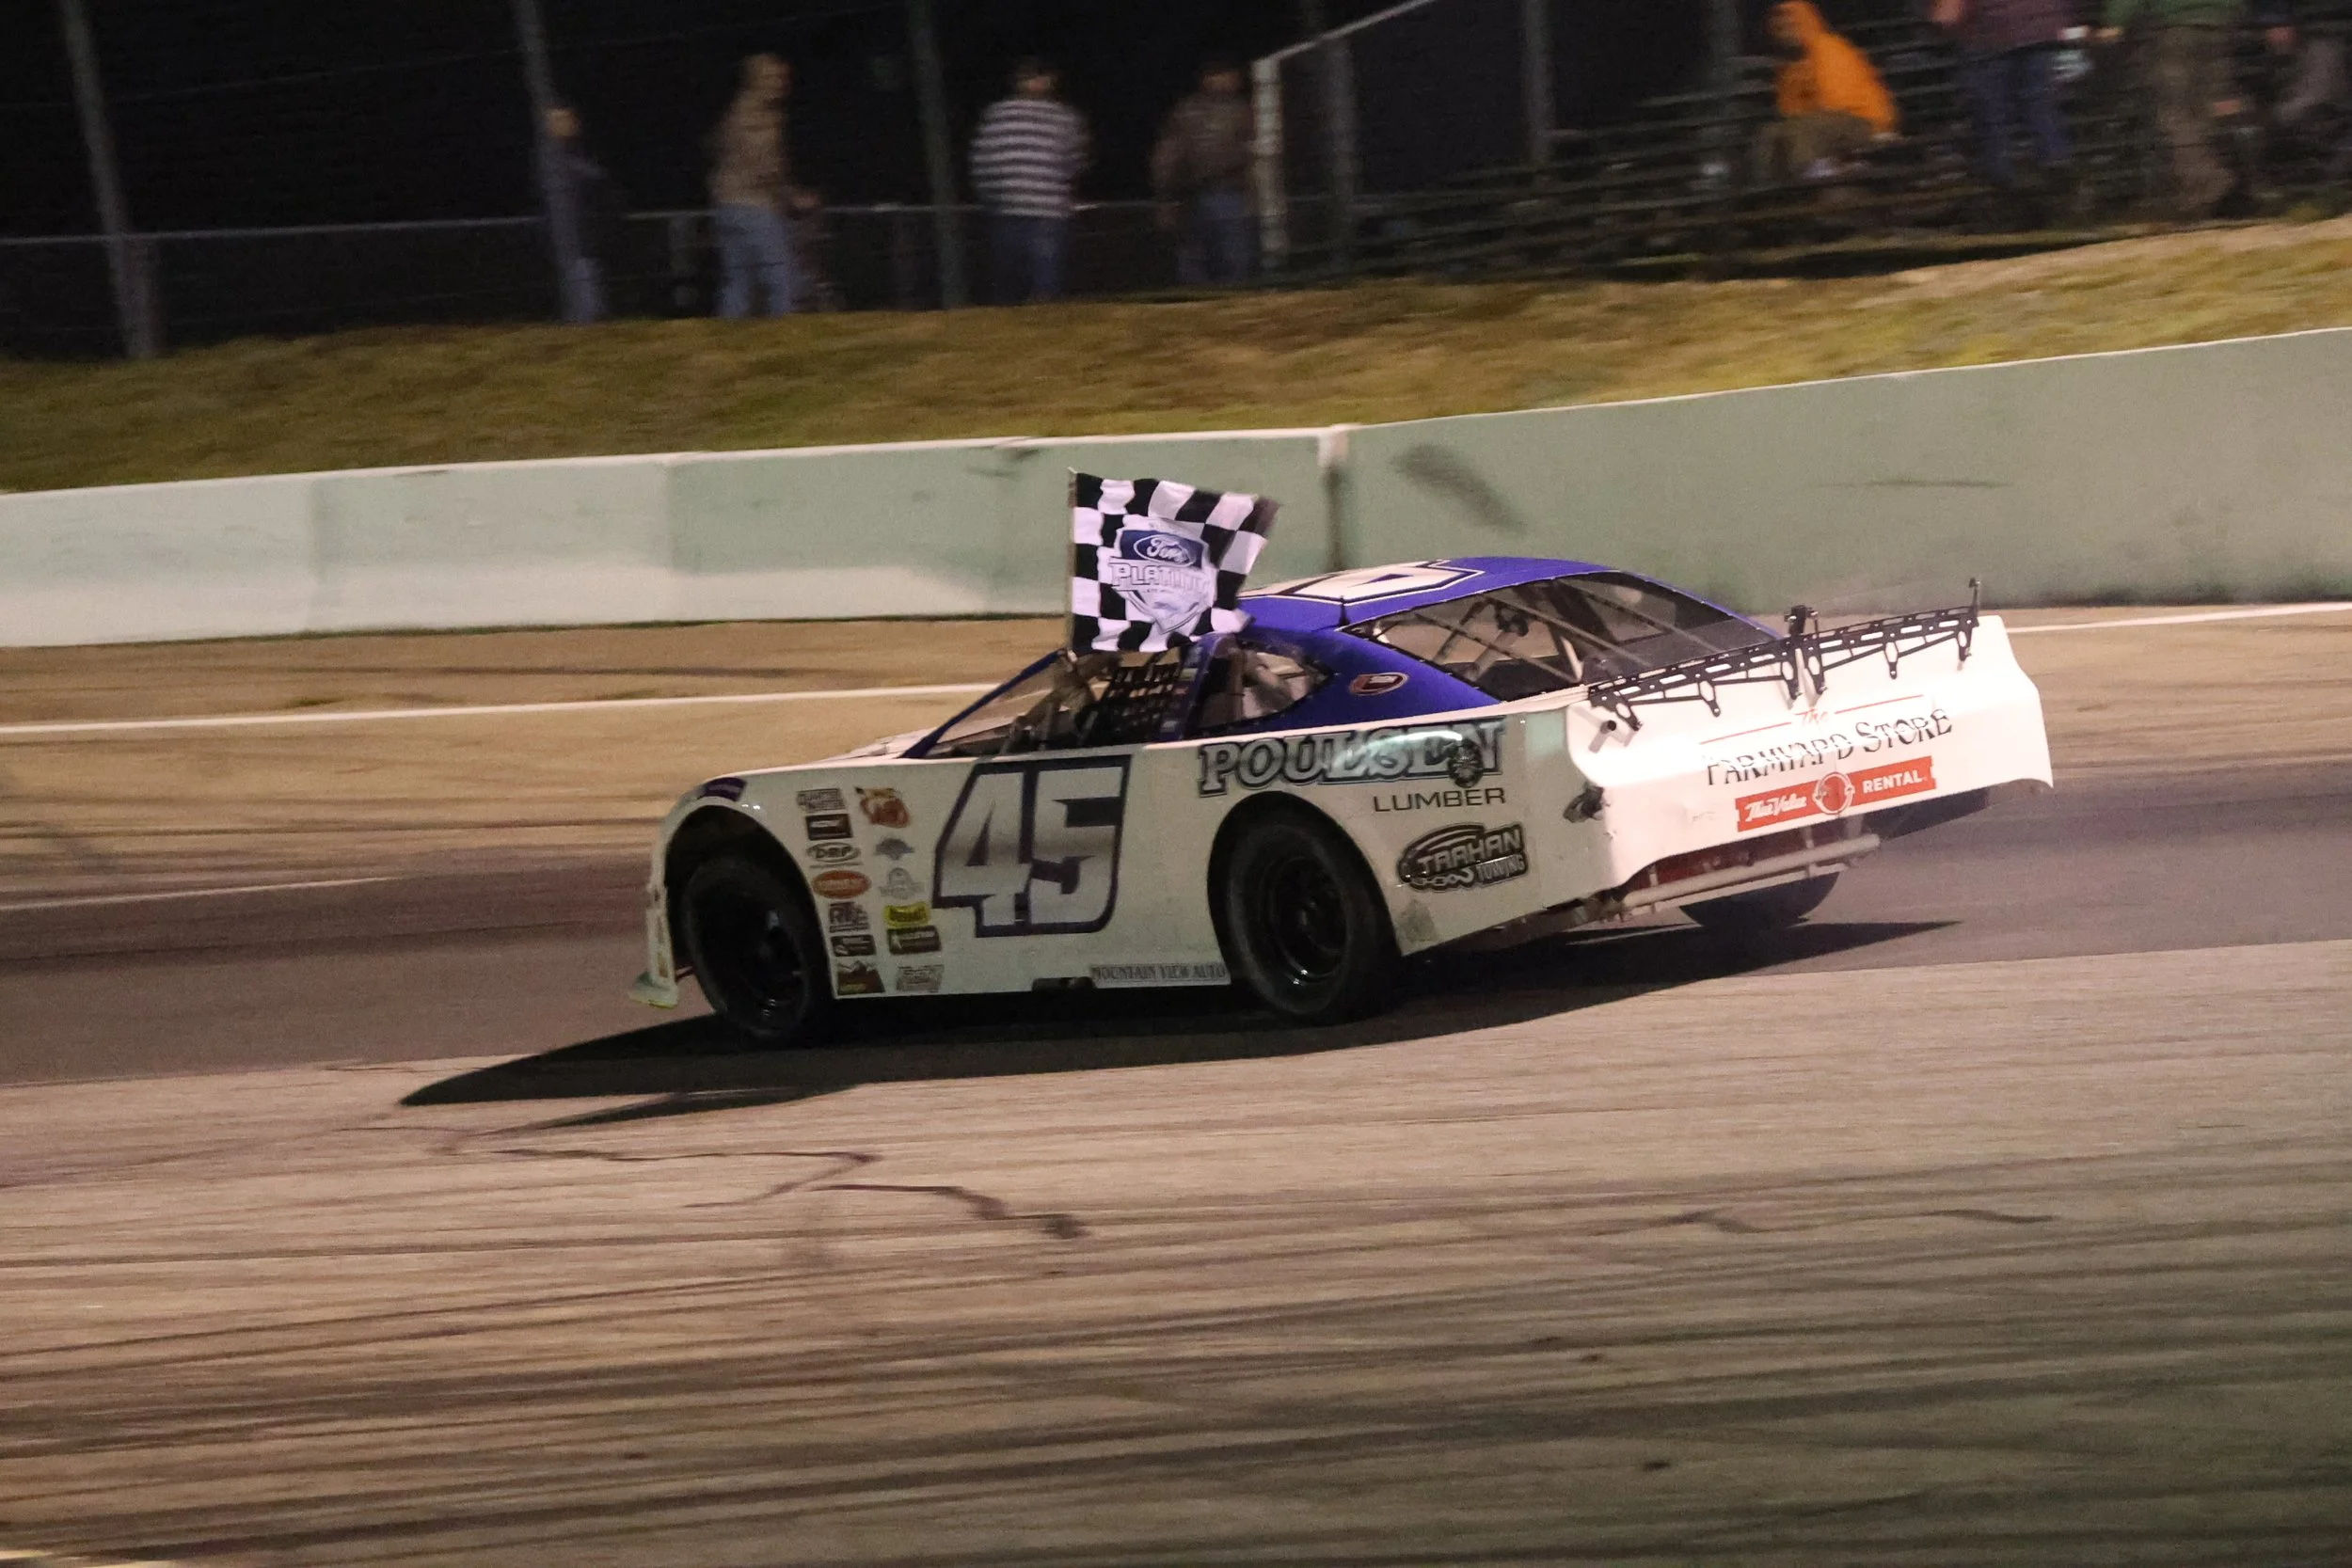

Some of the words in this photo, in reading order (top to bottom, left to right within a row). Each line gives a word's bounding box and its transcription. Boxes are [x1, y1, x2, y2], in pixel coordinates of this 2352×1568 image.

[1147, 537, 1189, 563] Ford
[1199, 717, 1505, 798] POULSEN
[1863, 769, 1923, 794] RENTAL
[1374, 787, 1506, 812] LUMBER
[932, 754, 1132, 938] 45
[1417, 829, 1522, 874] TRAHAN
[1475, 853, 1526, 882] TOWING
